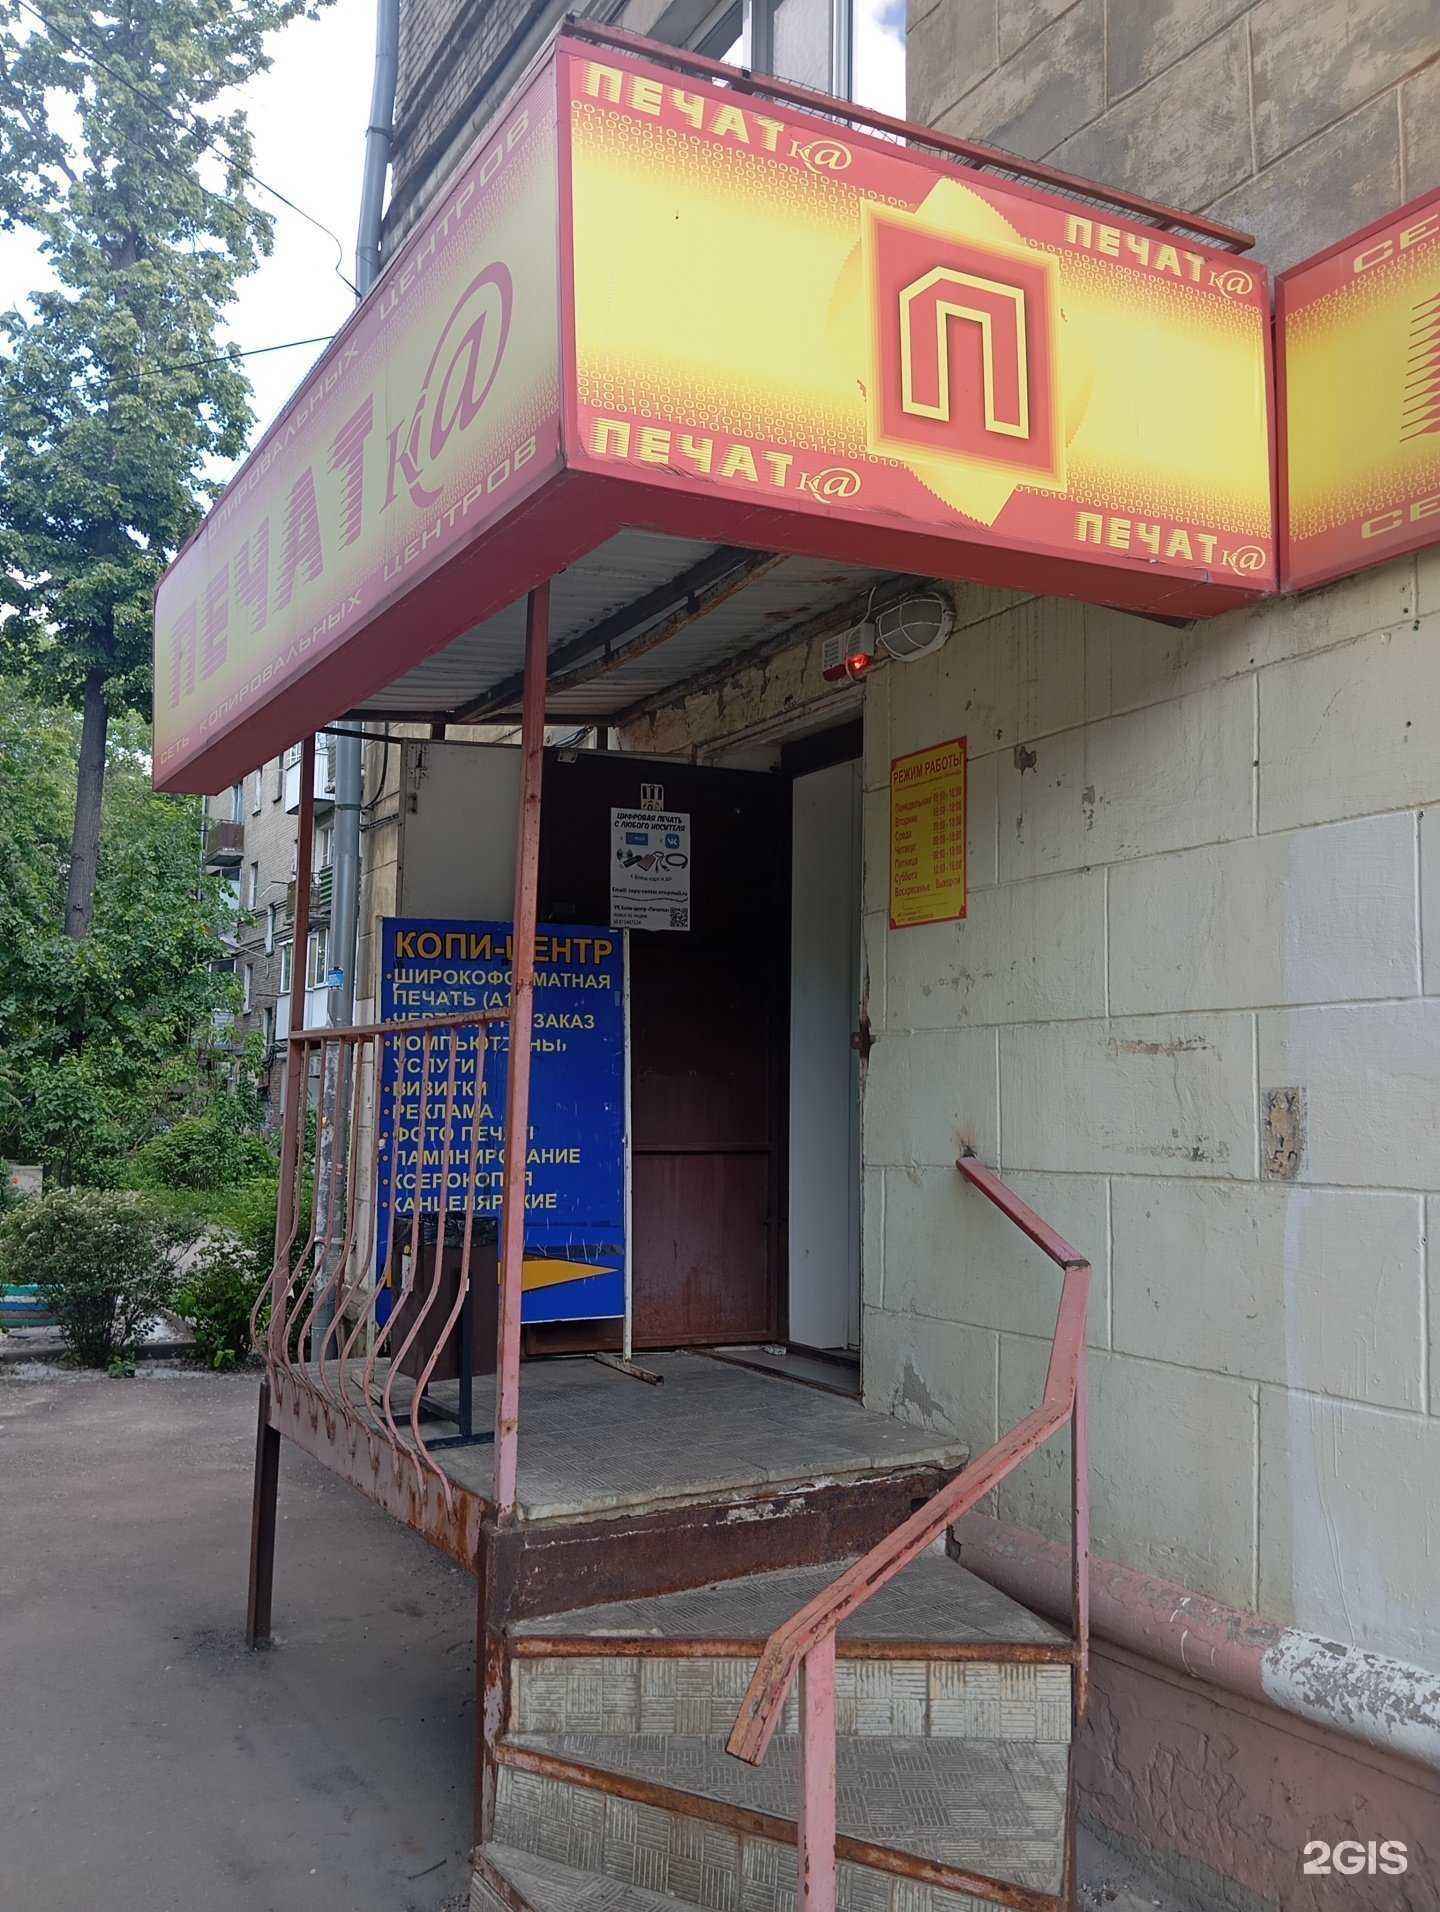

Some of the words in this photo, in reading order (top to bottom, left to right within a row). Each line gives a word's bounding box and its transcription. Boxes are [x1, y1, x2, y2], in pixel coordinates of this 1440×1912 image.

[205, 338, 360, 542] ОПИРОВАЛЬНЫХ
[379, 108, 529, 322] ЦЕНТРОВ
[160, 735, 190, 766] СЕТЬ
[200, 588, 362, 735] КОПИРОВАЛЬНЫХ
[384, 435, 536, 582] ЦЕНТРОВ
[892, 763, 923, 785] РЕЖИМ
[925, 752, 962, 776] РАБОТЫ
[396, 931, 613, 964] КОПИ-ЕНТР
[394, 968, 611, 989] ШИРОКОФОМАТНАЯ
[393, 990, 476, 1006] ПЕЧАТЬ
[534, 1013, 595, 1029] ЗАКАЗ
[392, 1103, 494, 1119] РЕКЛАМА
[393, 1126, 454, 1142] ФОТО
[461, 1126, 534, 1142] ПЕЧ
[396, 1149, 581, 1165] ЛАМНИРОАНИЕ
[395, 1172, 533, 1189] КСЕРОКОПЯ
[395, 1193, 558, 1212] КАНЦЕЛЯРКИЕ
